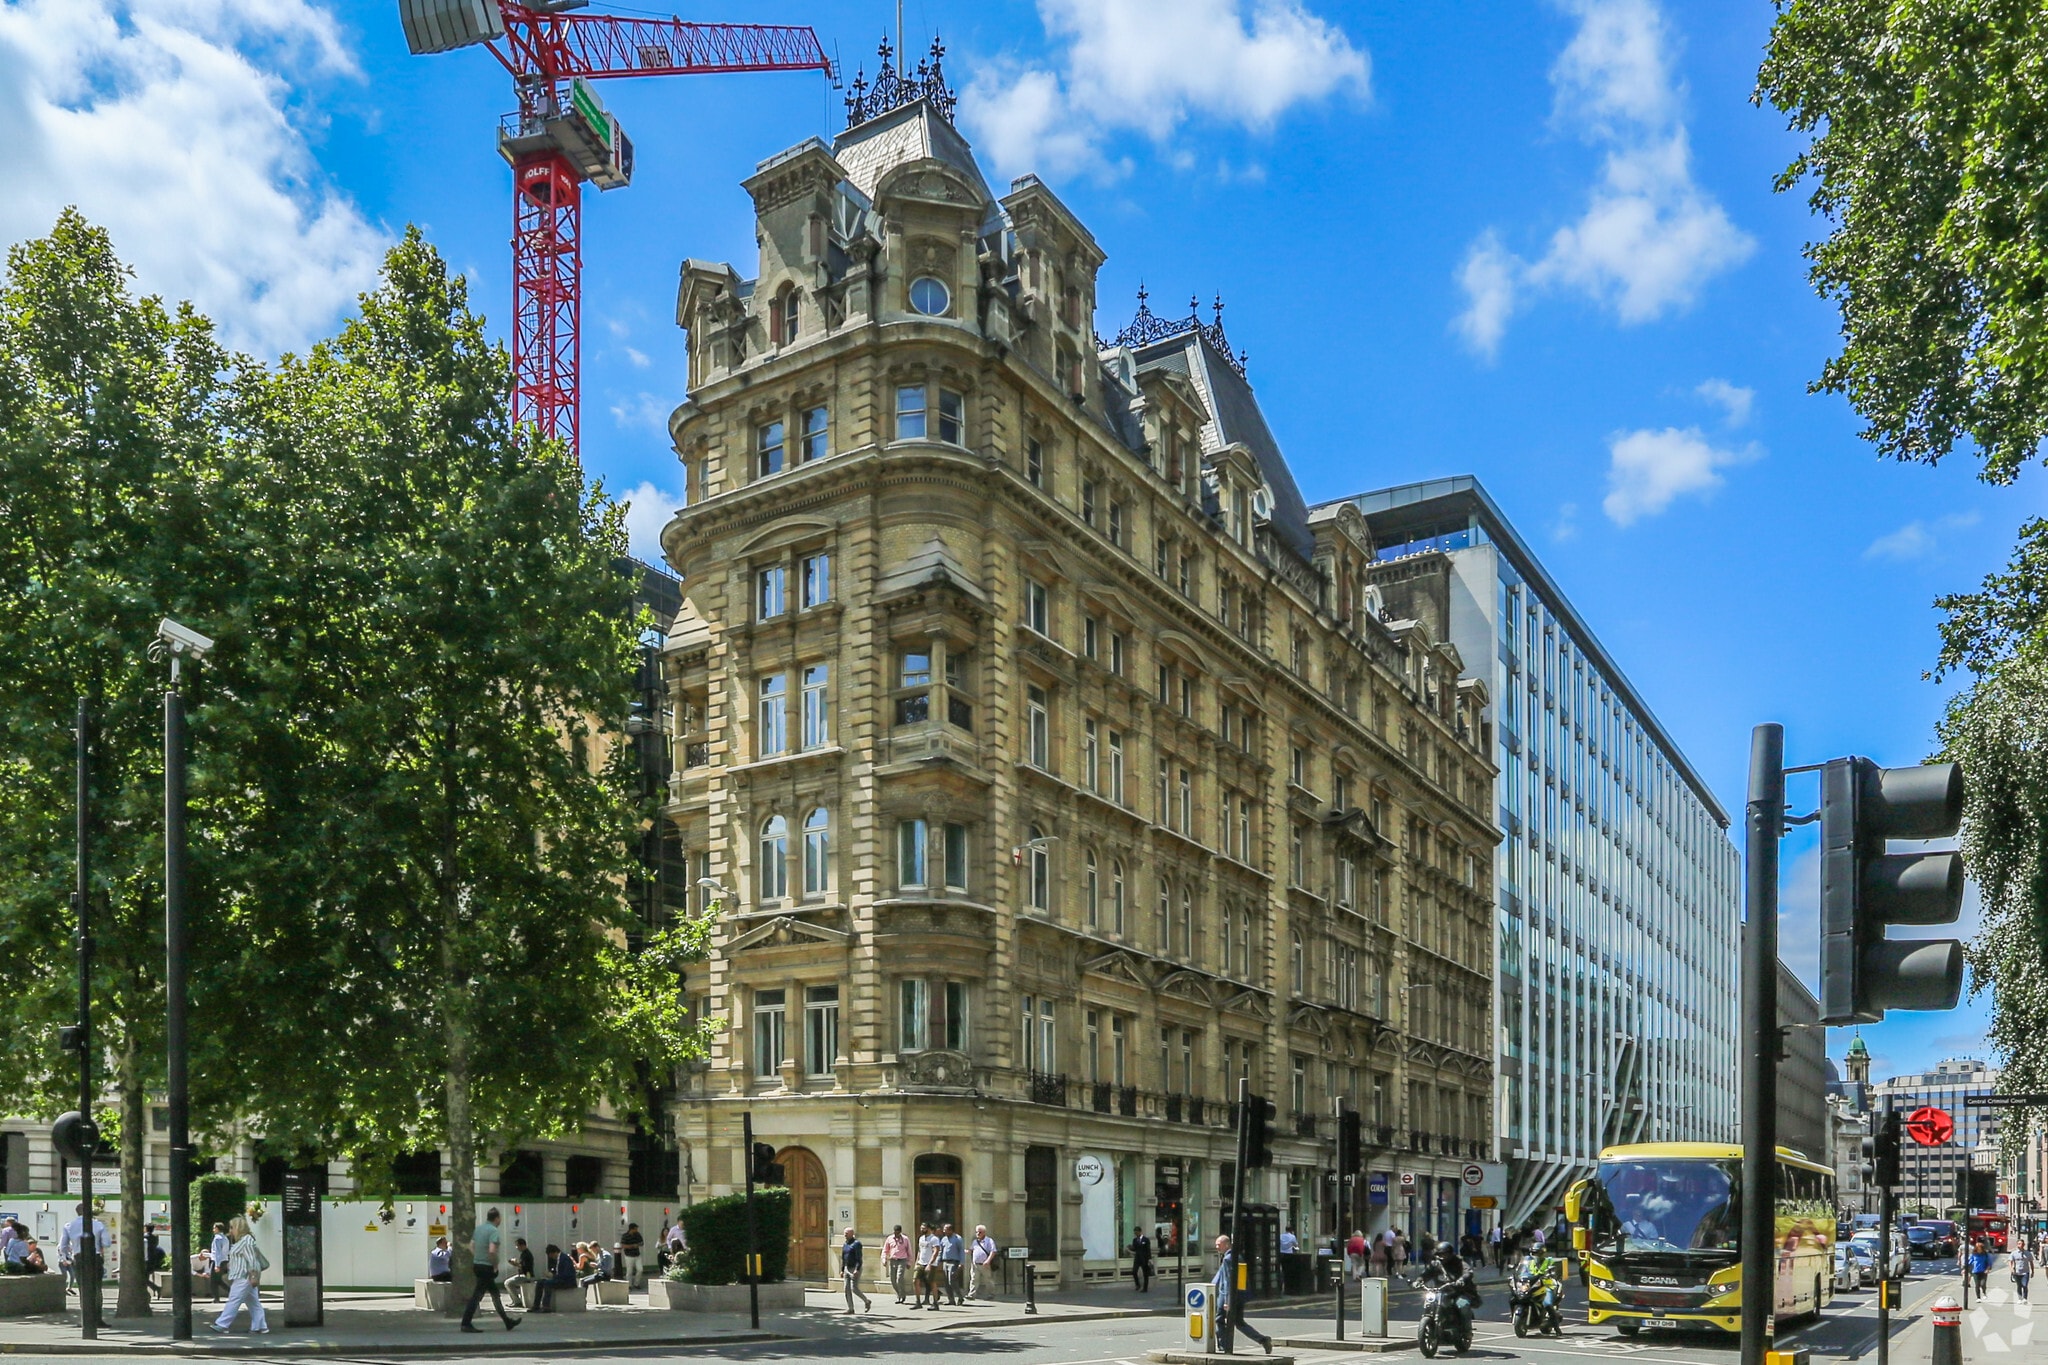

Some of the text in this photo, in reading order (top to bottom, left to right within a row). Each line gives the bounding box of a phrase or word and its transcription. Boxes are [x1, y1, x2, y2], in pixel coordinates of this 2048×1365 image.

[640, 50, 669, 67] WOLFF
[1370, 1184, 1386, 1192] CORAL
[841, 1210, 849, 1218] 15
[1640, 1276, 1679, 1285] SCANIA
